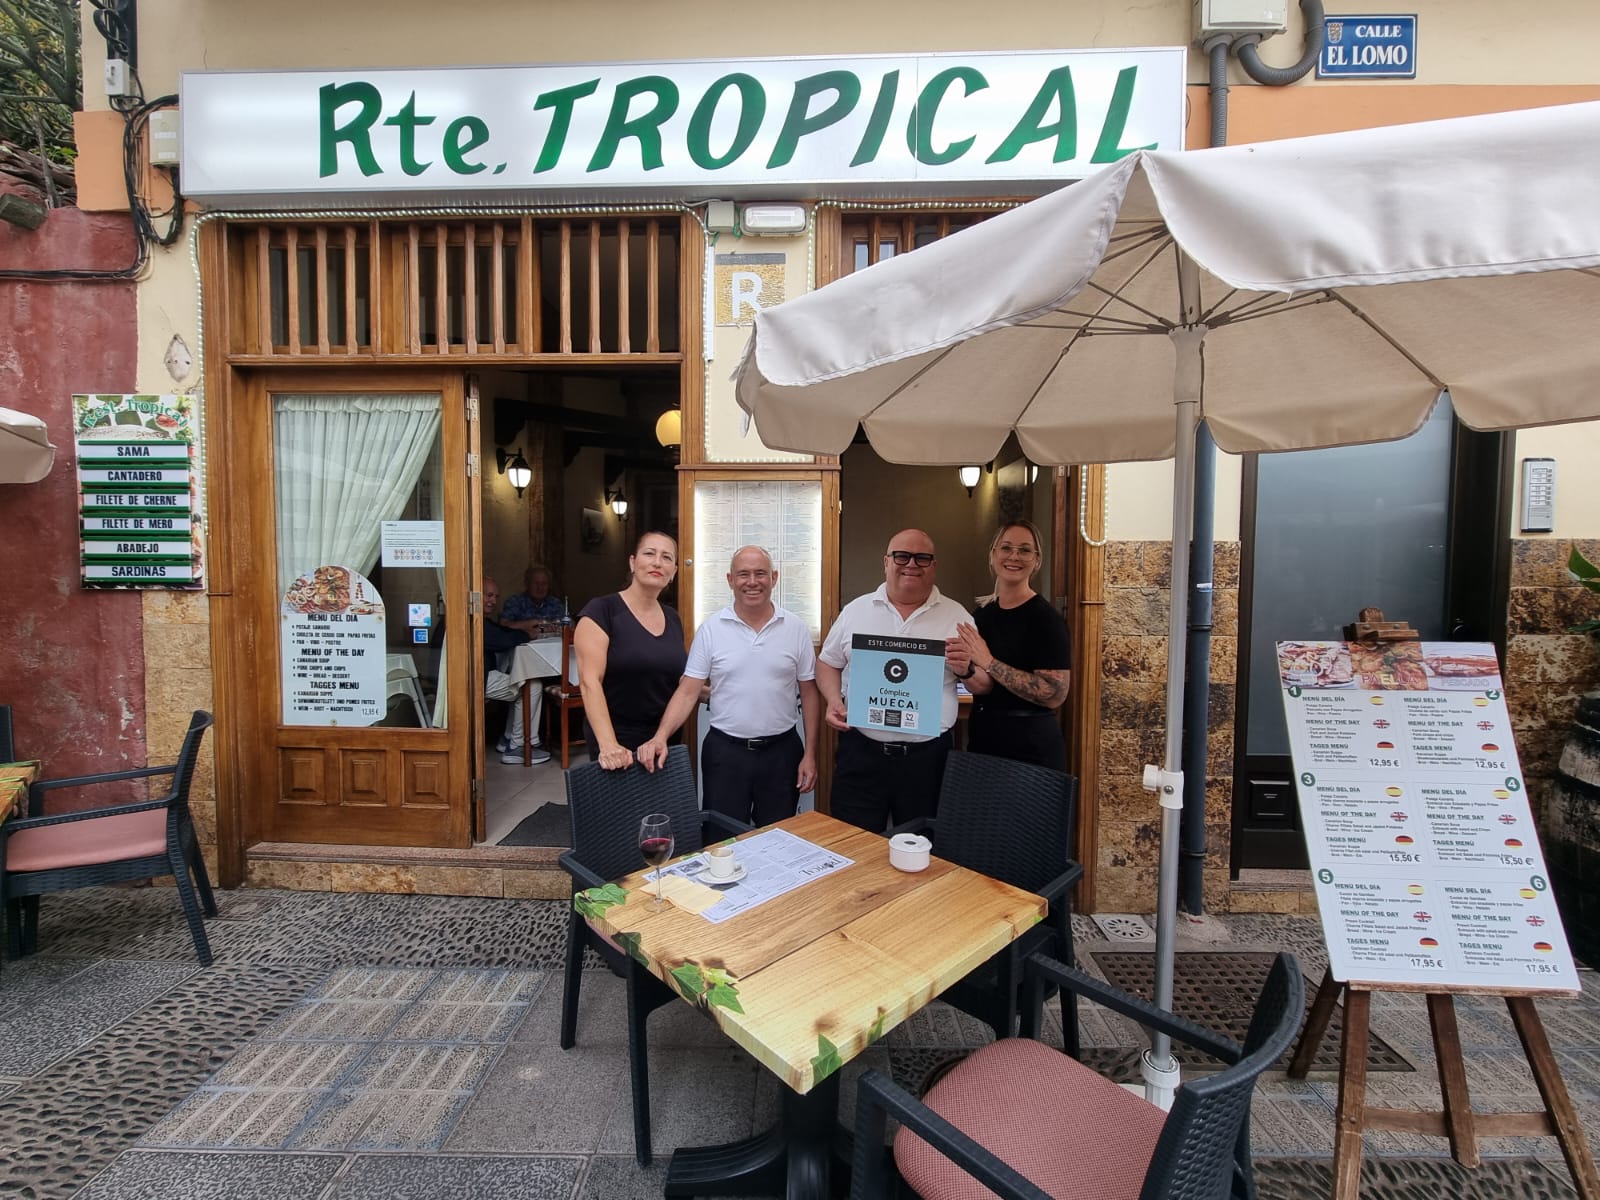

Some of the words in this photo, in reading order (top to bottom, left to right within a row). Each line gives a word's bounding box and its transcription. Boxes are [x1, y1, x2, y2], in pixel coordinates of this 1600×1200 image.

[1355, 25, 1402, 38] CALLE
[1327, 46, 1348, 65] EL
[1352, 45, 1407, 65] LOMO
[533, 65, 1159, 174] TROPICAL
[732, 271, 763, 319] R
[83, 401, 121, 428] Rest.
[127, 399, 189, 427] Tropical
[117, 447, 150, 457] SAMA
[108, 471, 162, 481] CANTADERO
[96, 495, 123, 505] FILETE
[129, 495, 139, 505] DE
[144, 495, 177, 505] CHERNE
[102, 519, 128, 528] FILETE
[134, 519, 144, 528] DE
[149, 519, 173, 529] MERO
[117, 543, 159, 553] ABADEJO
[112, 567, 166, 576] SARDINAS
[331, 614, 343, 622] DEL
[346, 614, 358, 622] DIA
[885, 641, 917, 649] COMERCIO
[890, 665, 902, 677] C
[339, 682, 359, 690] MENU
[880, 687, 910, 697] Cómplice
[869, 696, 913, 709] MUECA
[1370, 759, 1391, 767] 12,95
[1475, 761, 1498, 769] 12,95
[1390, 854, 1412, 862] 15,50
[1500, 856, 1523, 865] 15,50
[1411, 959, 1435, 968] 17,95
[1526, 964, 1550, 973] 17,95
